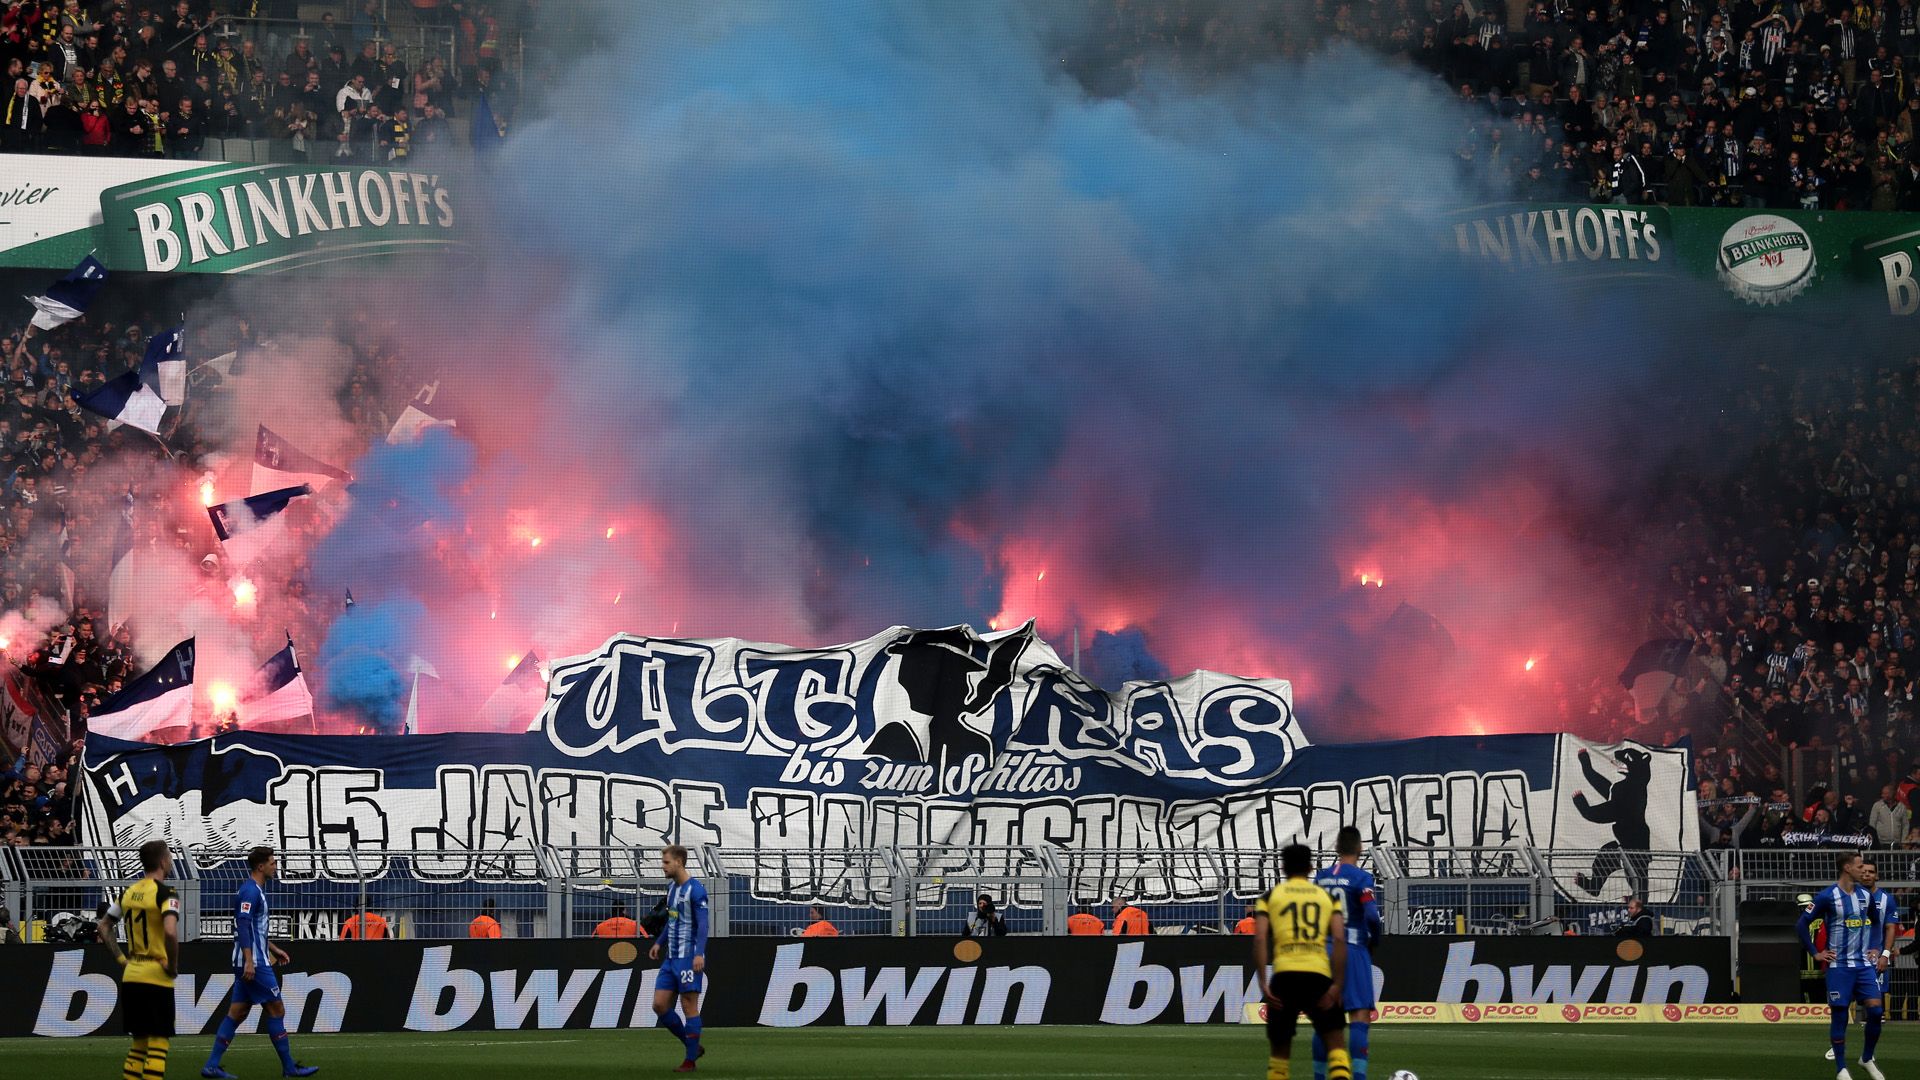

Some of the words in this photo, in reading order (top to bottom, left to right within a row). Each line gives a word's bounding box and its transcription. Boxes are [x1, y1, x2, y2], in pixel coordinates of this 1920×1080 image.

[0, 183, 59, 207] vier
[133, 170, 454, 273] BRINKHOFF's
[1731, 234, 1803, 261] BRINKHOFF's
[1879, 251, 1920, 315] B
[780, 744, 845, 784] bis
[858, 760, 934, 791] zum
[269, 764, 389, 882] 15
[410, 763, 725, 888] JAHRE
[125, 908, 149, 950] 11
[1279, 901, 1321, 941] 19
[680, 969, 695, 984] 23
[757, 939, 1051, 1028] bwin
[1436, 939, 1709, 1004] bwin
[1382, 1006, 1437, 1017] POCO
[1484, 1006, 1538, 1017] POCO
[1583, 1006, 1637, 1017] POCO
[1684, 1006, 1738, 1017] POCO
